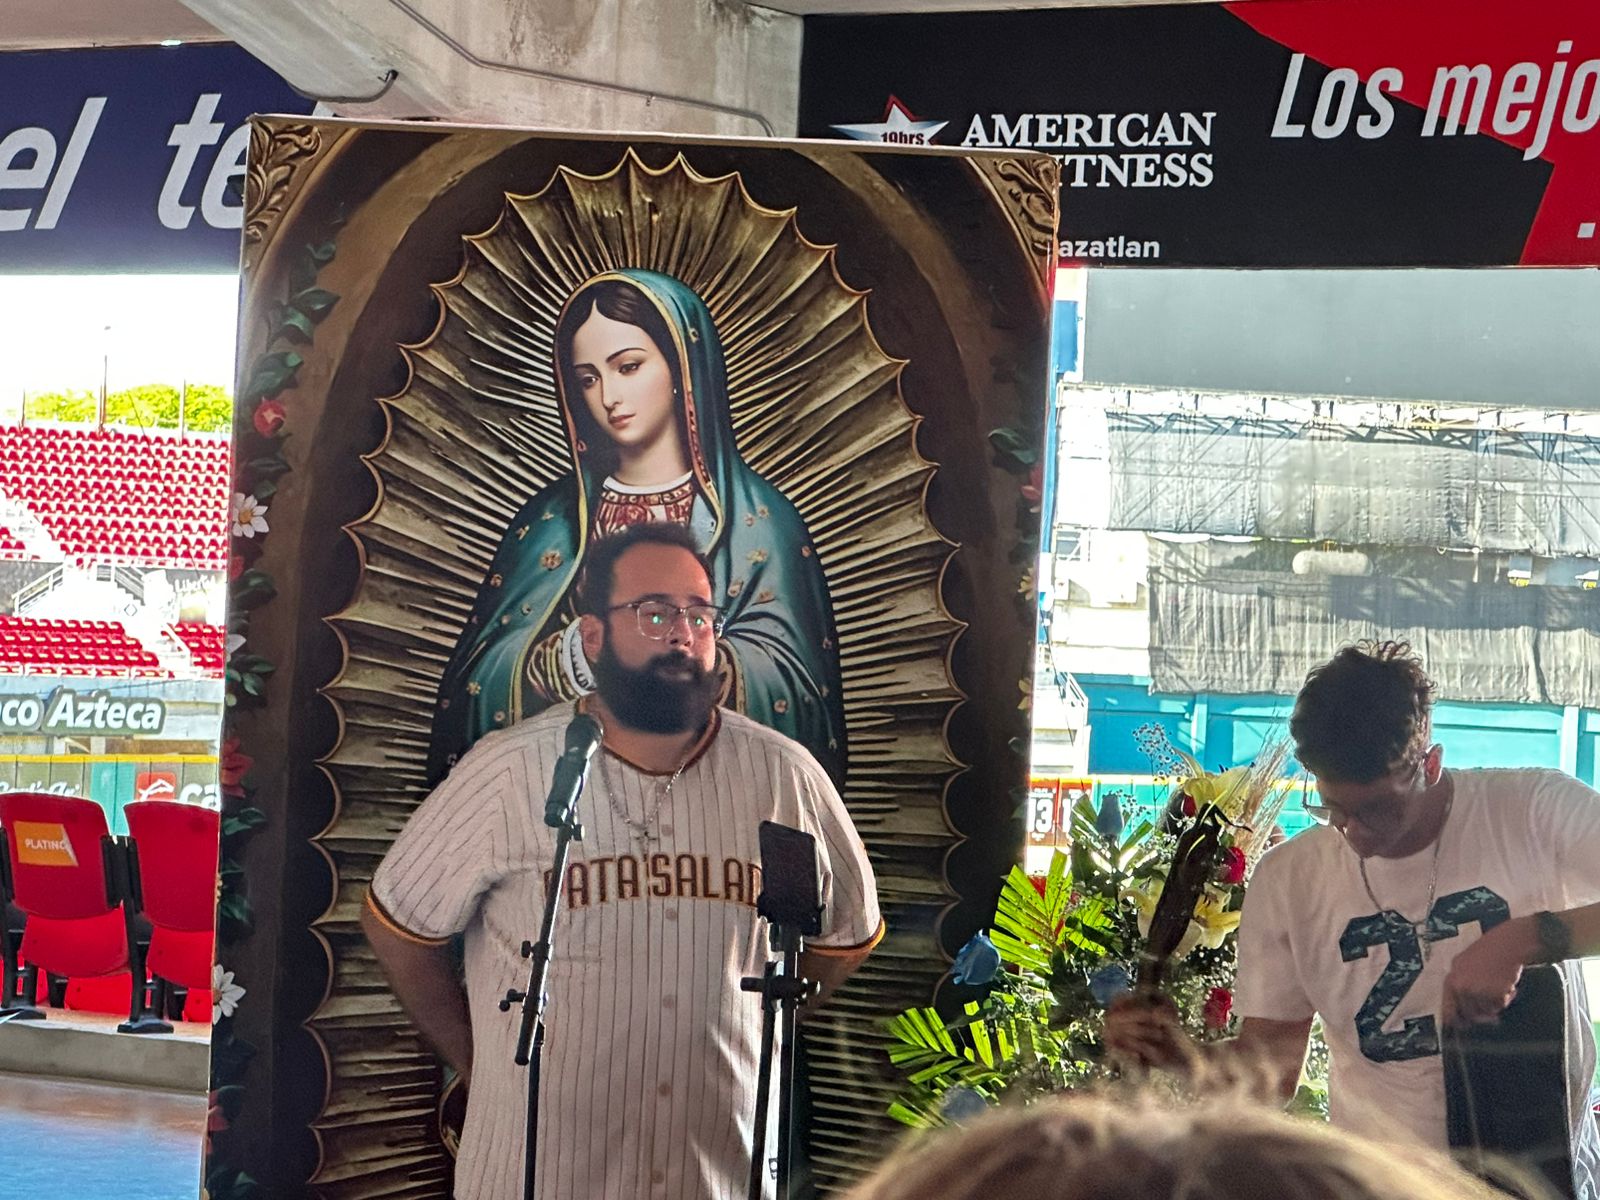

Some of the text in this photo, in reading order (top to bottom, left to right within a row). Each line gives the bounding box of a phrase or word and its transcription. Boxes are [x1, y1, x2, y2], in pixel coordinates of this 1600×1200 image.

[1270, 53, 1403, 139] Los
[960, 112, 1217, 147] AMERICAN
[1055, 153, 1214, 188] TNESS
[47, 693, 162, 729] Azteca
